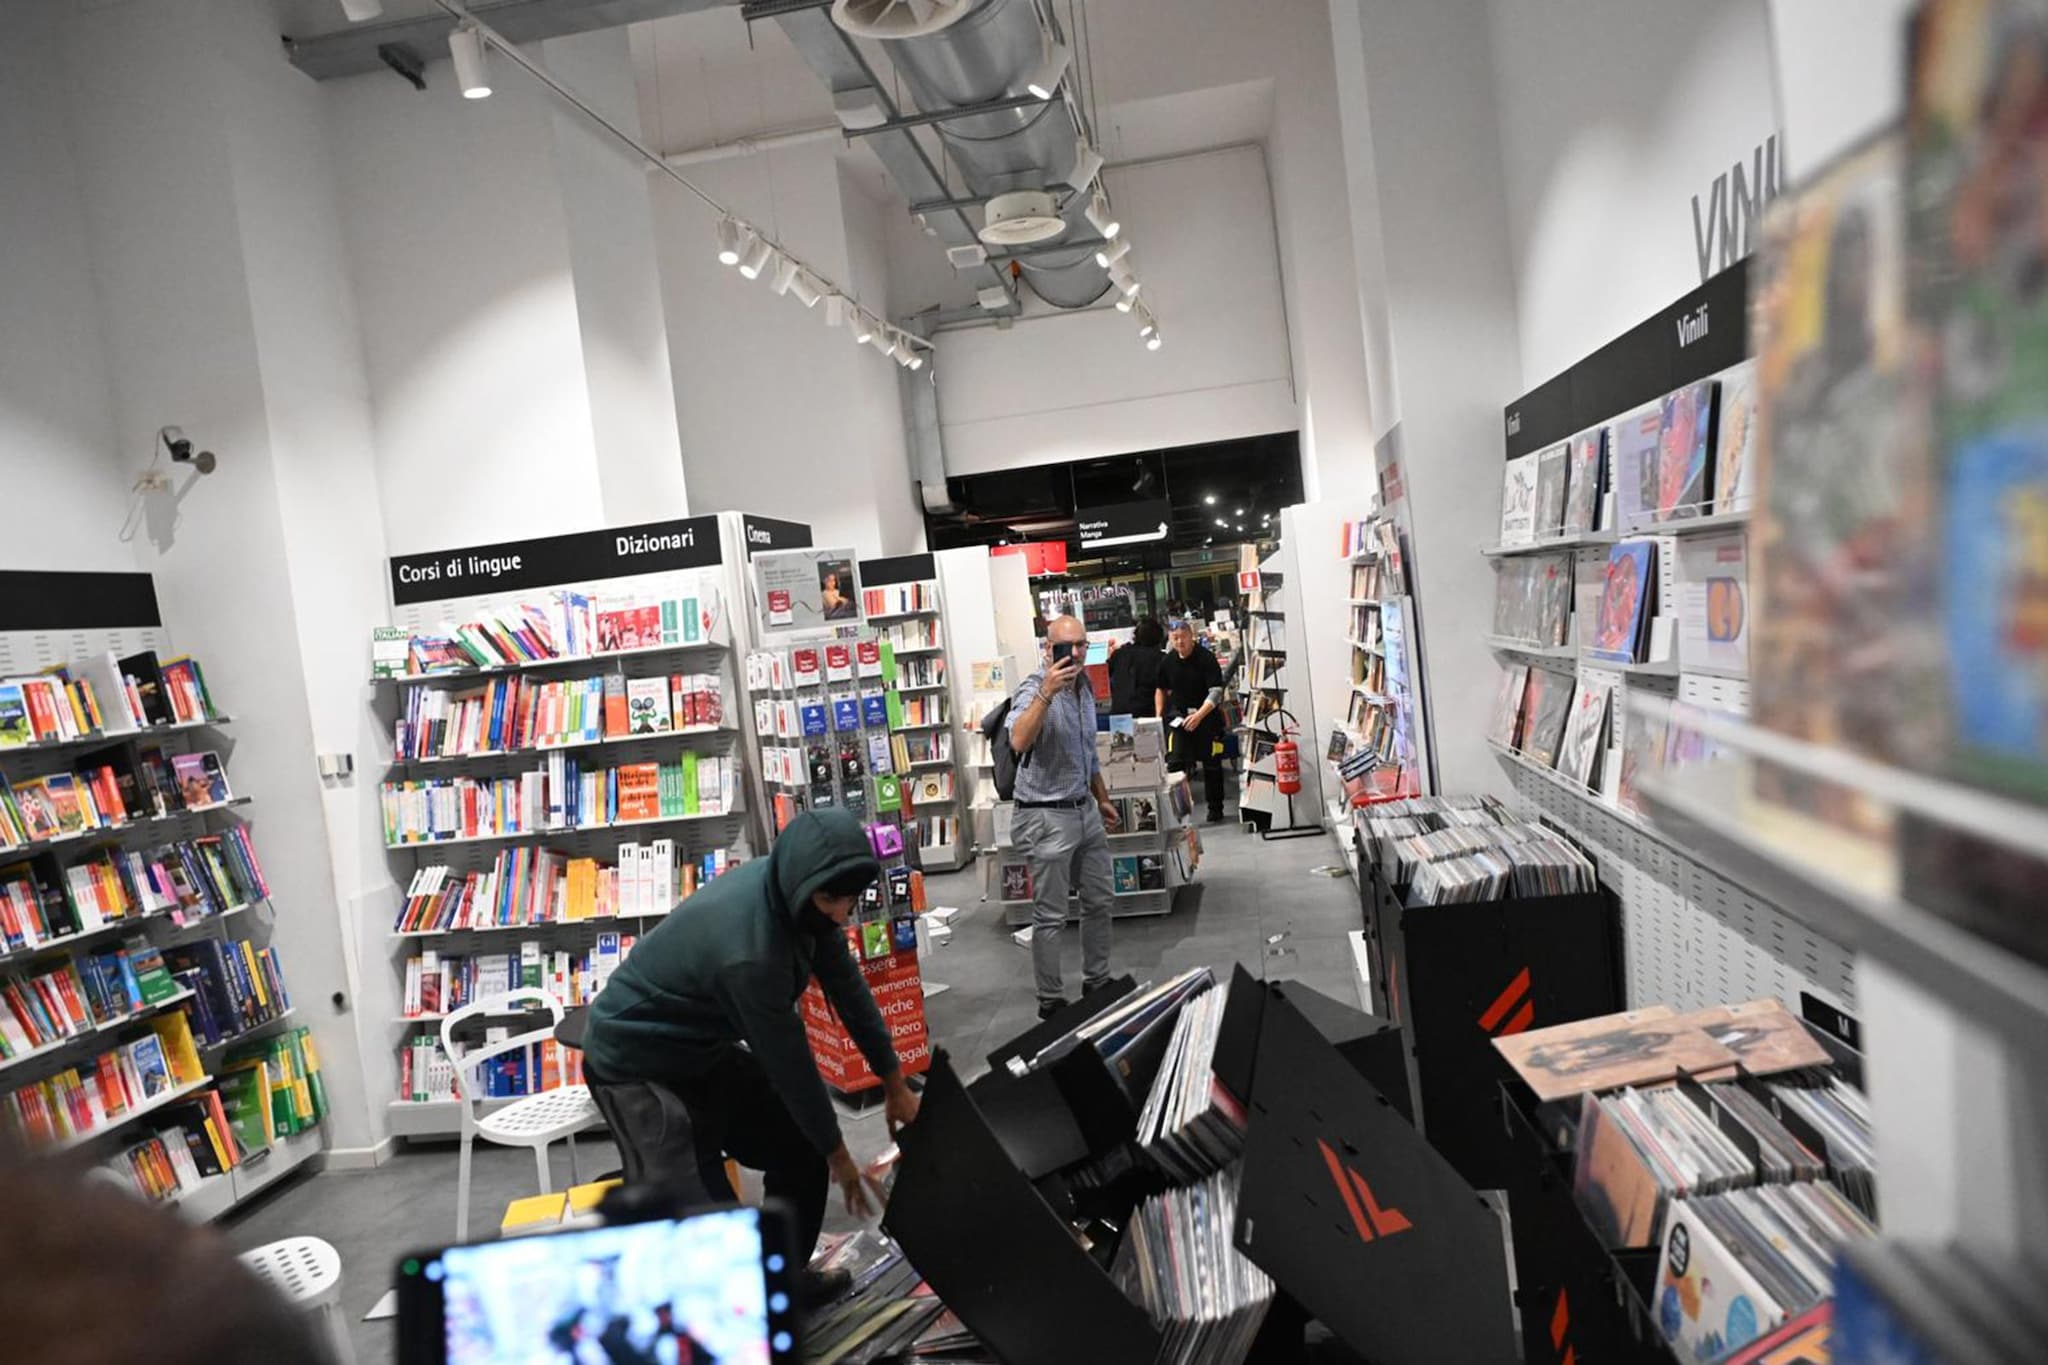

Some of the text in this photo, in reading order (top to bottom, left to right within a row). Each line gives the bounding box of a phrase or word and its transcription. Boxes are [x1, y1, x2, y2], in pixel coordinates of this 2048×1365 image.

[1676, 303, 1709, 348] Vinili
[747, 524, 772, 544] Cinema
[1079, 520, 1108, 530] Narrativa
[1080, 530, 1102, 539] Manga
[616, 527, 694, 556] Dizionari
[399, 555, 522, 583] Corsi di lingue
[858, 957, 897, 976] essere
[870, 976, 920, 996] enimento
[879, 998, 914, 1016] riche
